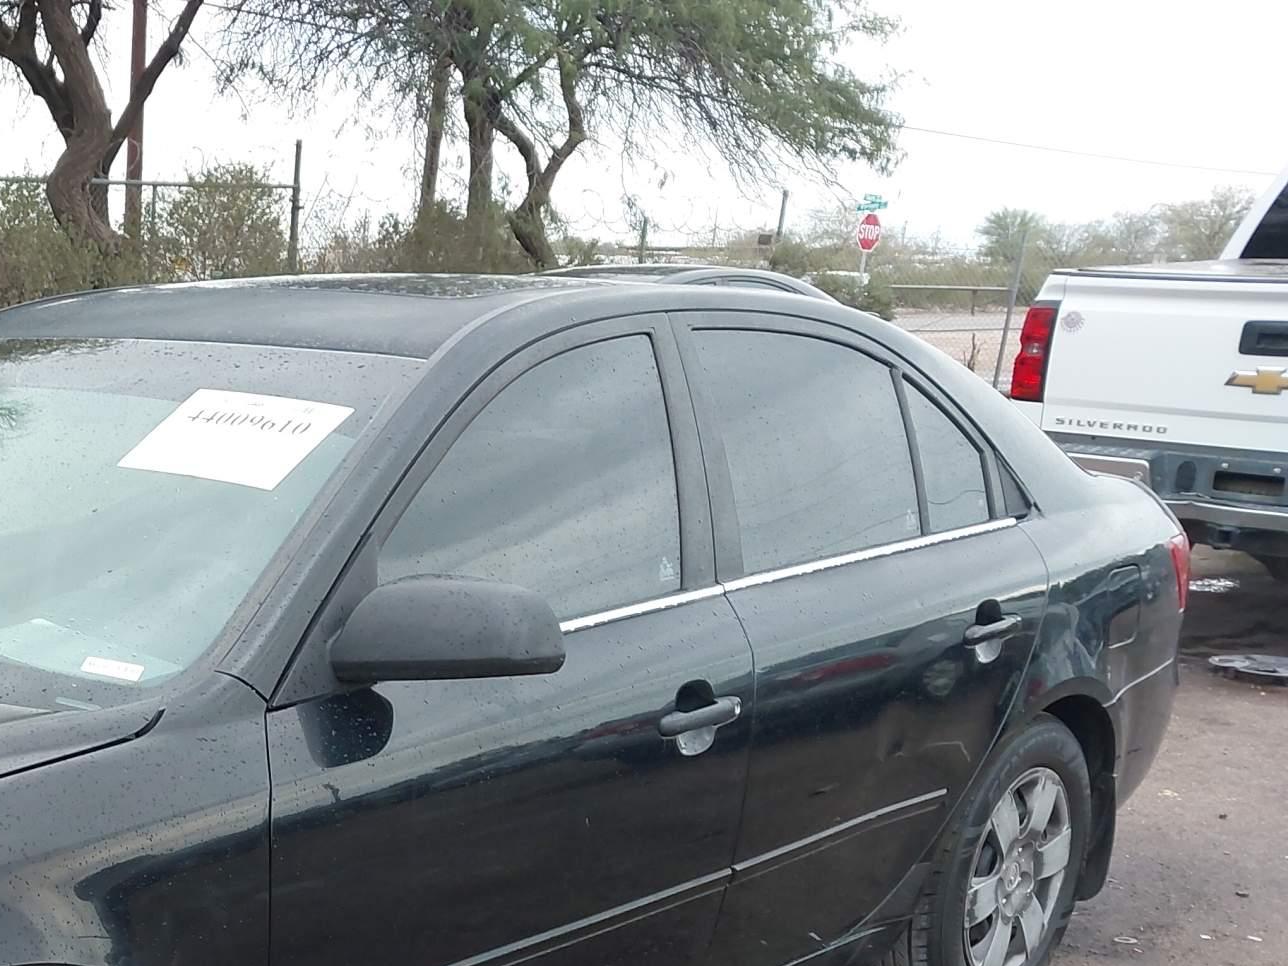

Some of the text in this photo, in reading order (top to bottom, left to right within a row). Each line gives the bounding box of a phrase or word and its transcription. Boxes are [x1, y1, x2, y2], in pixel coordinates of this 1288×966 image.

[858, 223, 881, 240] STOP
[187, 409, 312, 435] 44009610
[1055, 417, 1169, 434] SILVERADO
